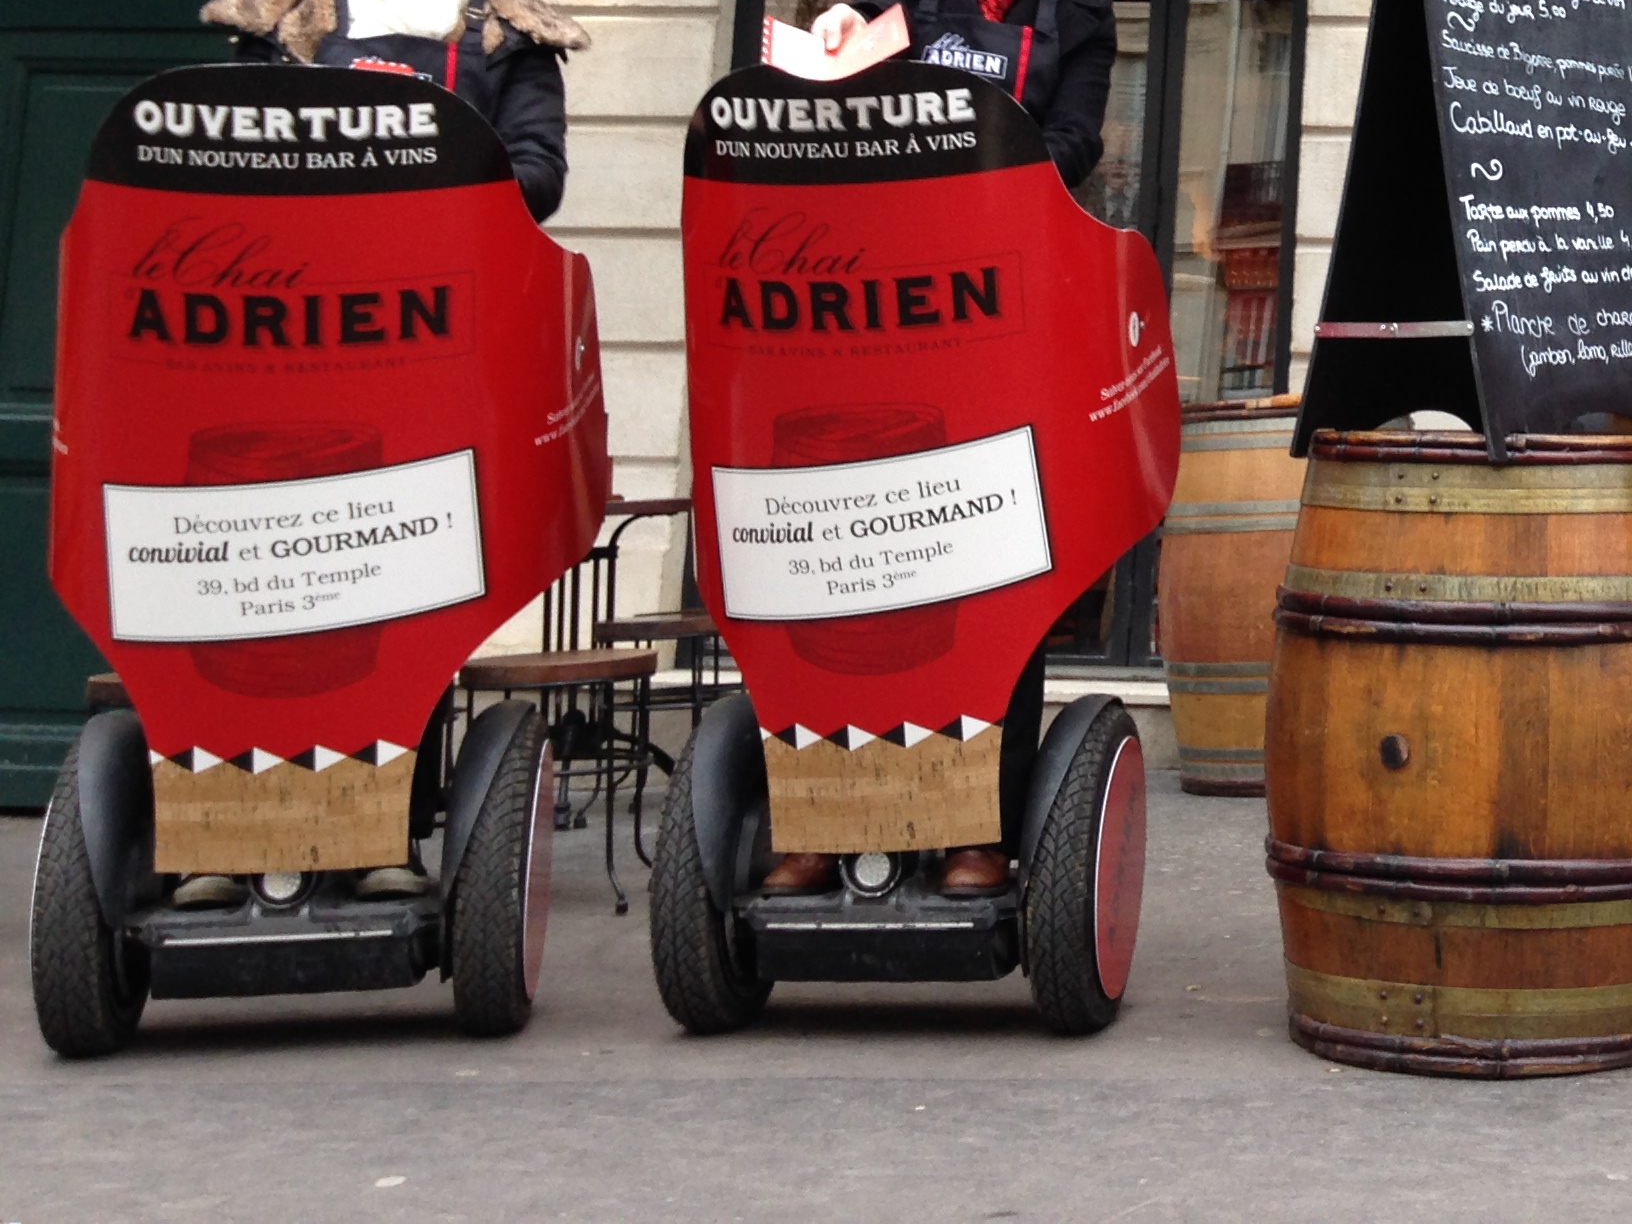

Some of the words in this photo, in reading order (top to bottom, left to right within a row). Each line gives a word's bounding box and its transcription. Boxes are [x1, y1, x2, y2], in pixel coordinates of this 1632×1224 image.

[1538, 0, 1566, 20] 5,00
[926, 48, 1001, 74] ADRIEN
[1441, 29, 1495, 58] Saucisse
[1497, 44, 1510, 60] de
[709, 88, 977, 132] OUVERTURE
[1482, 79, 1500, 95] de
[1546, 90, 1563, 106] au
[1567, 91, 1586, 108] vin
[133, 100, 440, 143] OUVERTURE
[1449, 101, 1534, 138] Cabillaud
[1537, 124, 1554, 140] en
[188, 148, 300, 170] NOUVEAU
[305, 150, 357, 170] BAR
[360, 145, 381, 168] À
[384, 146, 438, 166] VINS
[754, 140, 849, 159] NOUVEAU
[854, 138, 900, 157] BAR
[905, 133, 922, 153] À
[926, 131, 976, 151] VINS
[1505, 206, 1529, 220] aux
[1530, 205, 1581, 228] pommes
[1585, 200, 1615, 224] 4,50
[161, 217, 314, 289] Chai
[740, 206, 867, 275] Chai
[1466, 228, 1498, 252] Pain
[1499, 238, 1537, 263] perdu
[1536, 234, 1552, 252] à
[1554, 233, 1569, 251] la
[1571, 234, 1615, 251] vanille
[1472, 269, 1523, 292] Salade
[1523, 272, 1540, 288] de
[1540, 264, 1578, 294] fruits
[1580, 270, 1599, 284] au
[1601, 266, 1620, 283] vin
[127, 285, 453, 348] ADRIEN
[718, 266, 1002, 334] ADRIEN
[1567, 313, 1591, 335] de
[764, 493, 878, 517] Découvrez
[885, 487, 910, 503] ce
[917, 475, 961, 499] lieu
[173, 514, 303, 535] Découvrez
[311, 509, 340, 525] ce
[348, 497, 395, 518] lieu
[732, 521, 815, 545] convivial
[822, 523, 844, 541] et
[849, 492, 1004, 539] GOURMAND
[128, 540, 230, 563] convivial
[239, 544, 262, 562] et
[270, 516, 439, 560] GOURMAND
[819, 554, 843, 574] bd
[849, 550, 876, 569] du
[879, 539, 954, 566] Temple
[233, 575, 259, 593] bd
[266, 572, 296, 590] du
[301, 562, 382, 588] Temple
[826, 575, 877, 597] Paris
[240, 598, 296, 617] Paris
